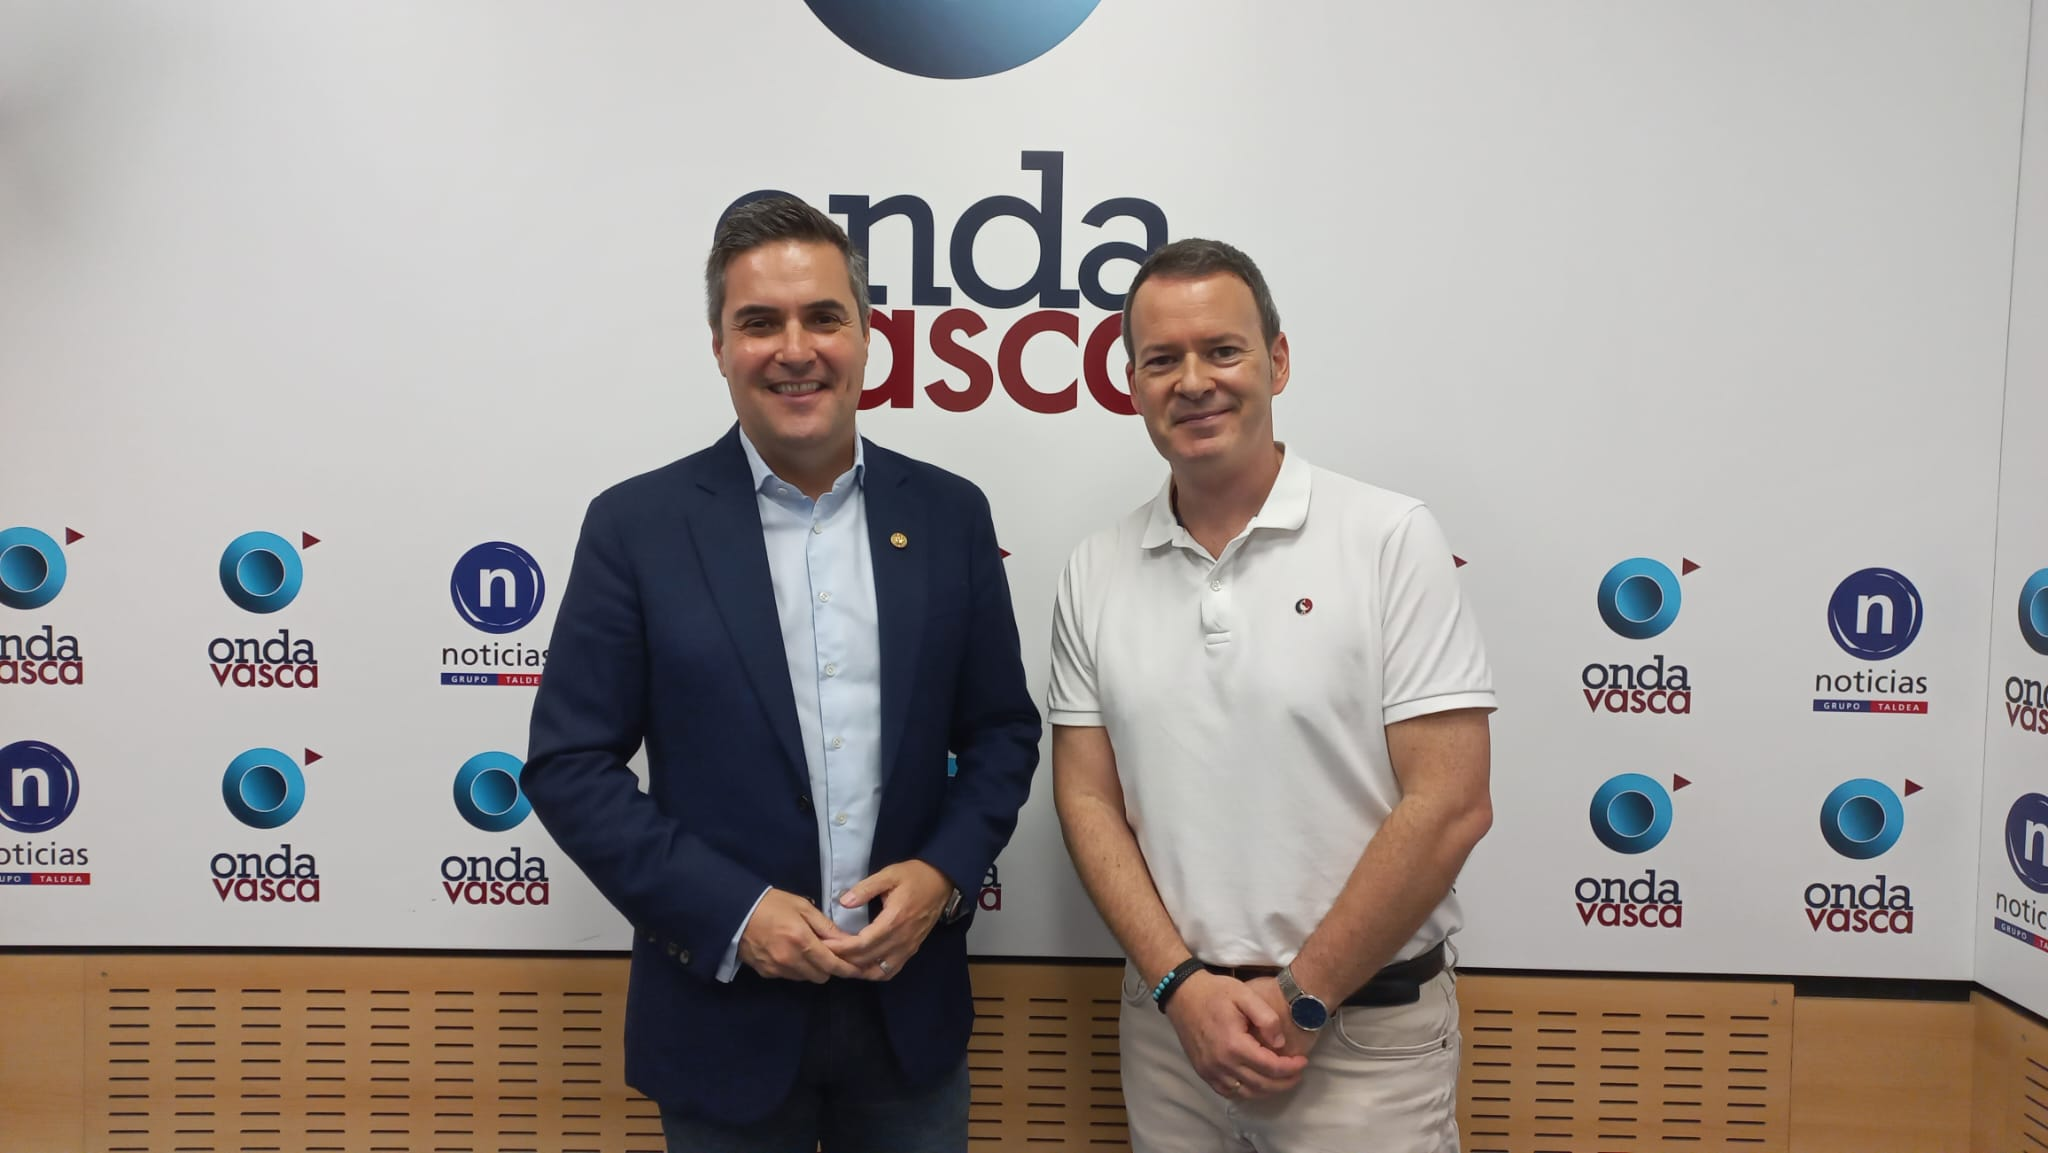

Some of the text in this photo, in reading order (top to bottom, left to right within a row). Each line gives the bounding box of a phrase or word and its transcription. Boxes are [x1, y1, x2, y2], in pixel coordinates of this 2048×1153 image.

[714, 150, 1169, 311] nda
[479, 568, 517, 609] n
[1856, 594, 1894, 635] n
[0, 625, 83, 661] nda
[208, 629, 318, 665] onda
[0, 660, 84, 686] asca
[210, 663, 319, 689] vasca
[451, 675, 540, 685] GRUPO TALDE
[1582, 655, 1692, 691] onda
[1815, 669, 1928, 695] noticias
[1583, 688, 1692, 715] vasca
[2005, 676, 2048, 710] on
[1823, 702, 1920, 712] GRUPO TALDEA
[11, 767, 50, 807] n
[0, 841, 89, 867] oticias
[210, 844, 320, 880] onda
[441, 848, 549, 884] onda
[39, 875, 83, 883] TALDEA
[212, 878, 320, 903] vasca
[1574, 870, 1683, 905] onda
[443, 881, 549, 906] vasca
[1804, 875, 1914, 911] onda
[1576, 903, 1683, 929] vasca
[1805, 908, 1914, 935] vasca
[2001, 922, 2028, 941] GRUPO
